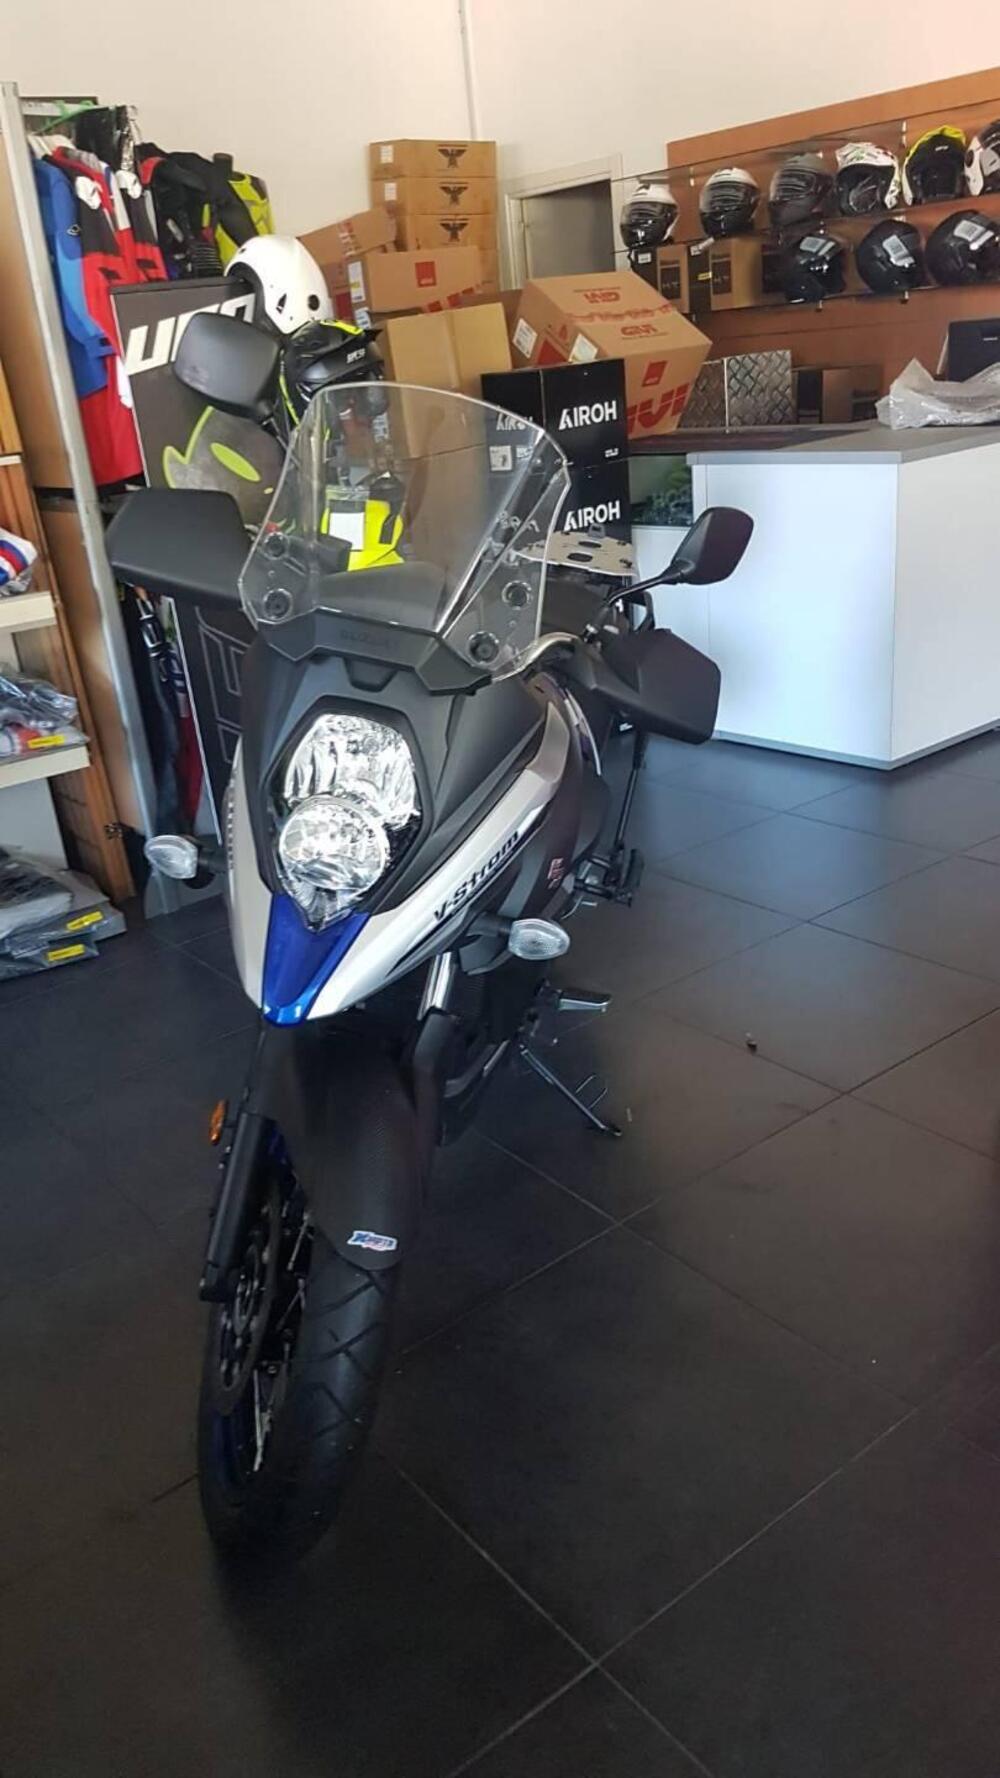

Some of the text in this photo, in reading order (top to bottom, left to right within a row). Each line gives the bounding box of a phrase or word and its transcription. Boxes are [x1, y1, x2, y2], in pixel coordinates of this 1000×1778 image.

[558, 400, 618, 431] AIROH
[563, 500, 621, 532] AIROH
[434, 831, 519, 921] V-Strom
